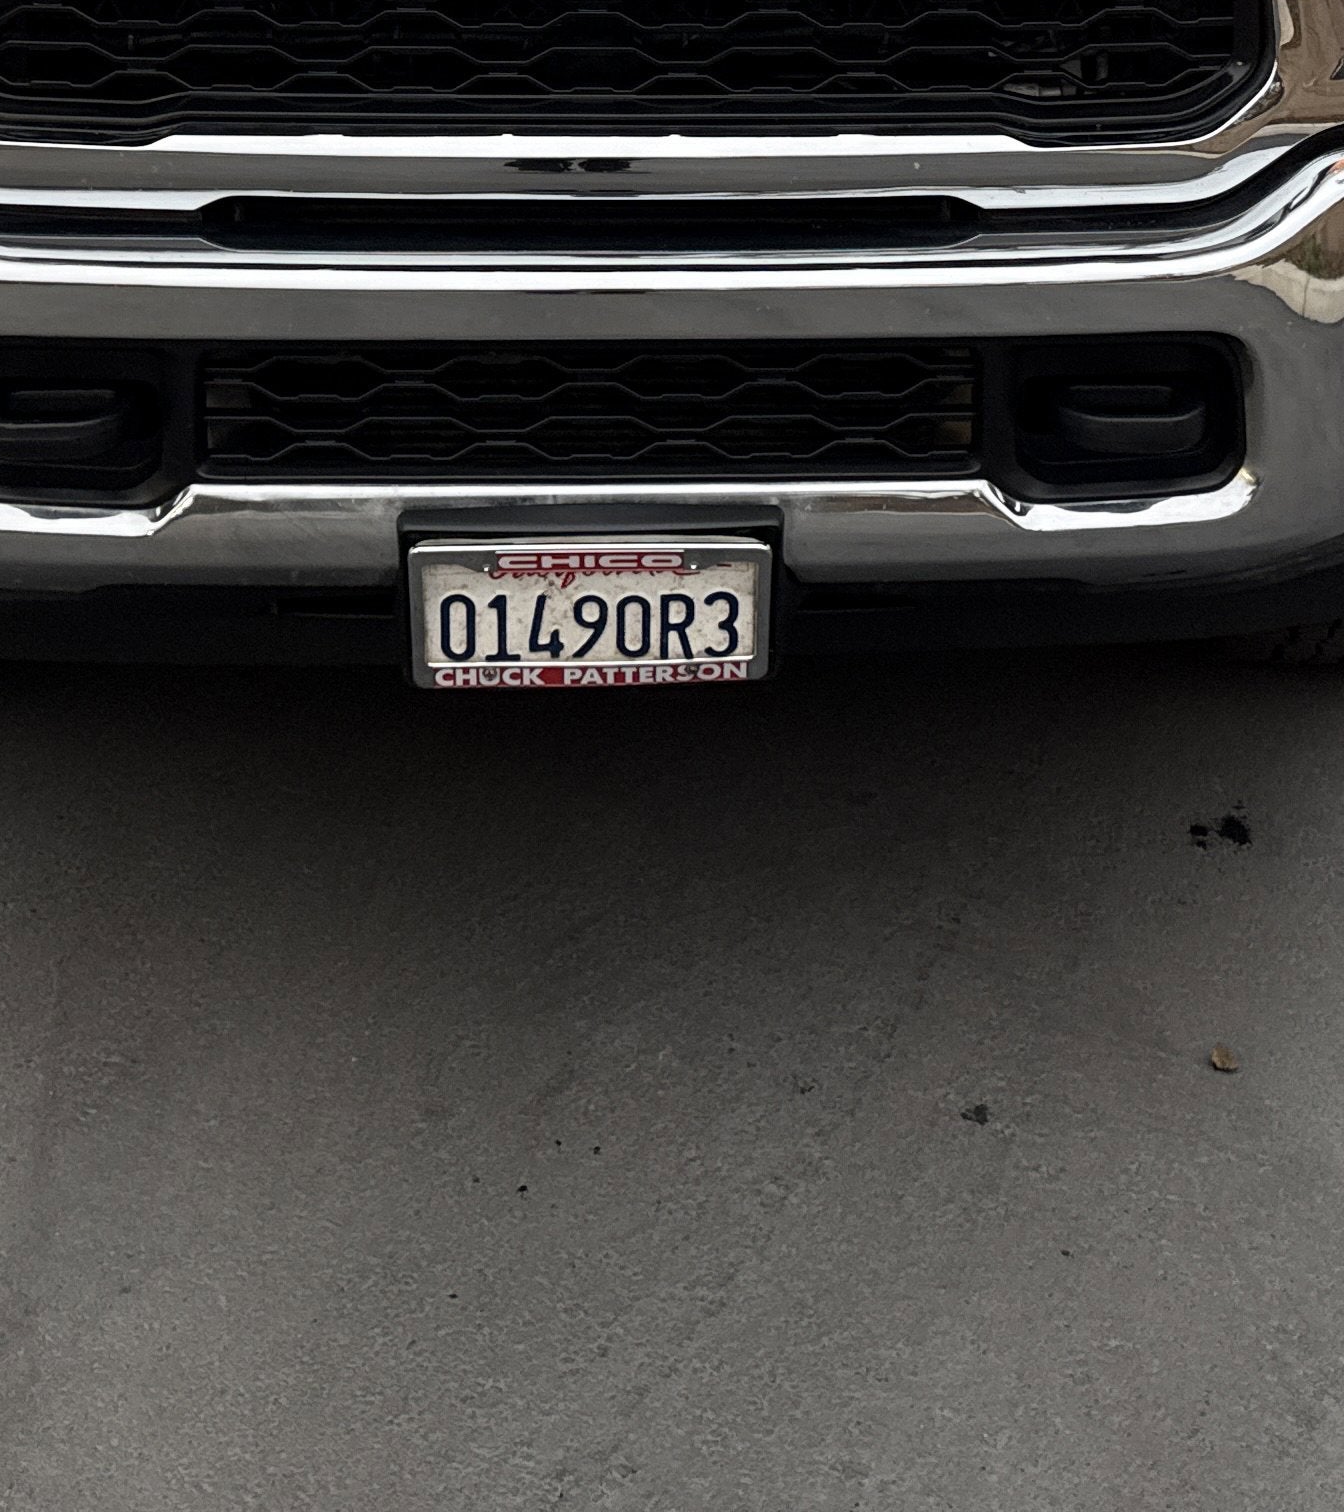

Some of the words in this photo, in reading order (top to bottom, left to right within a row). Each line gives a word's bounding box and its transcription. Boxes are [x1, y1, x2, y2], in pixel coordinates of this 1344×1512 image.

[497, 554, 683, 570] CHICO
[439, 591, 740, 662] 01490R3
[434, 666, 545, 687] CHUCK
[563, 662, 748, 686] PATTERSON
